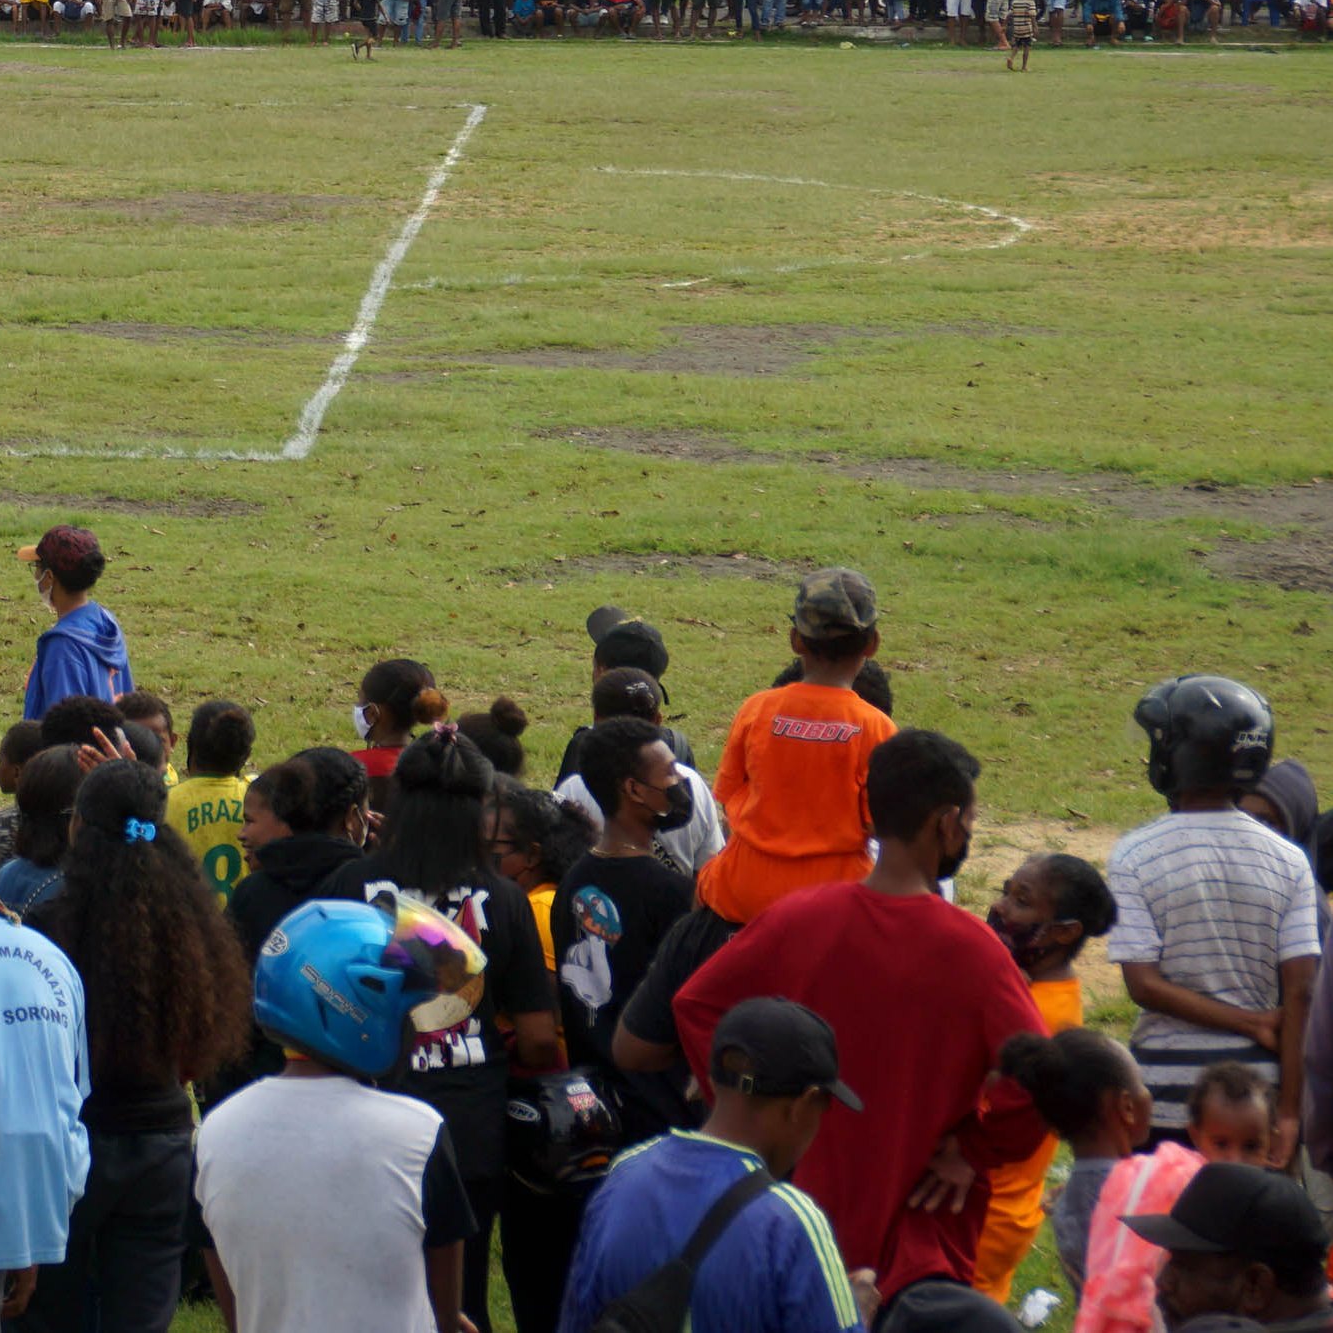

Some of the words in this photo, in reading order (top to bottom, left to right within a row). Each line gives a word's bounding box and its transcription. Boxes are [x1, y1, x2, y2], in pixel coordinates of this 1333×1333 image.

[773, 715, 862, 743] TOBOT
[187, 798, 244, 834] BRAZ
[2, 1006, 69, 1029] SORONG
